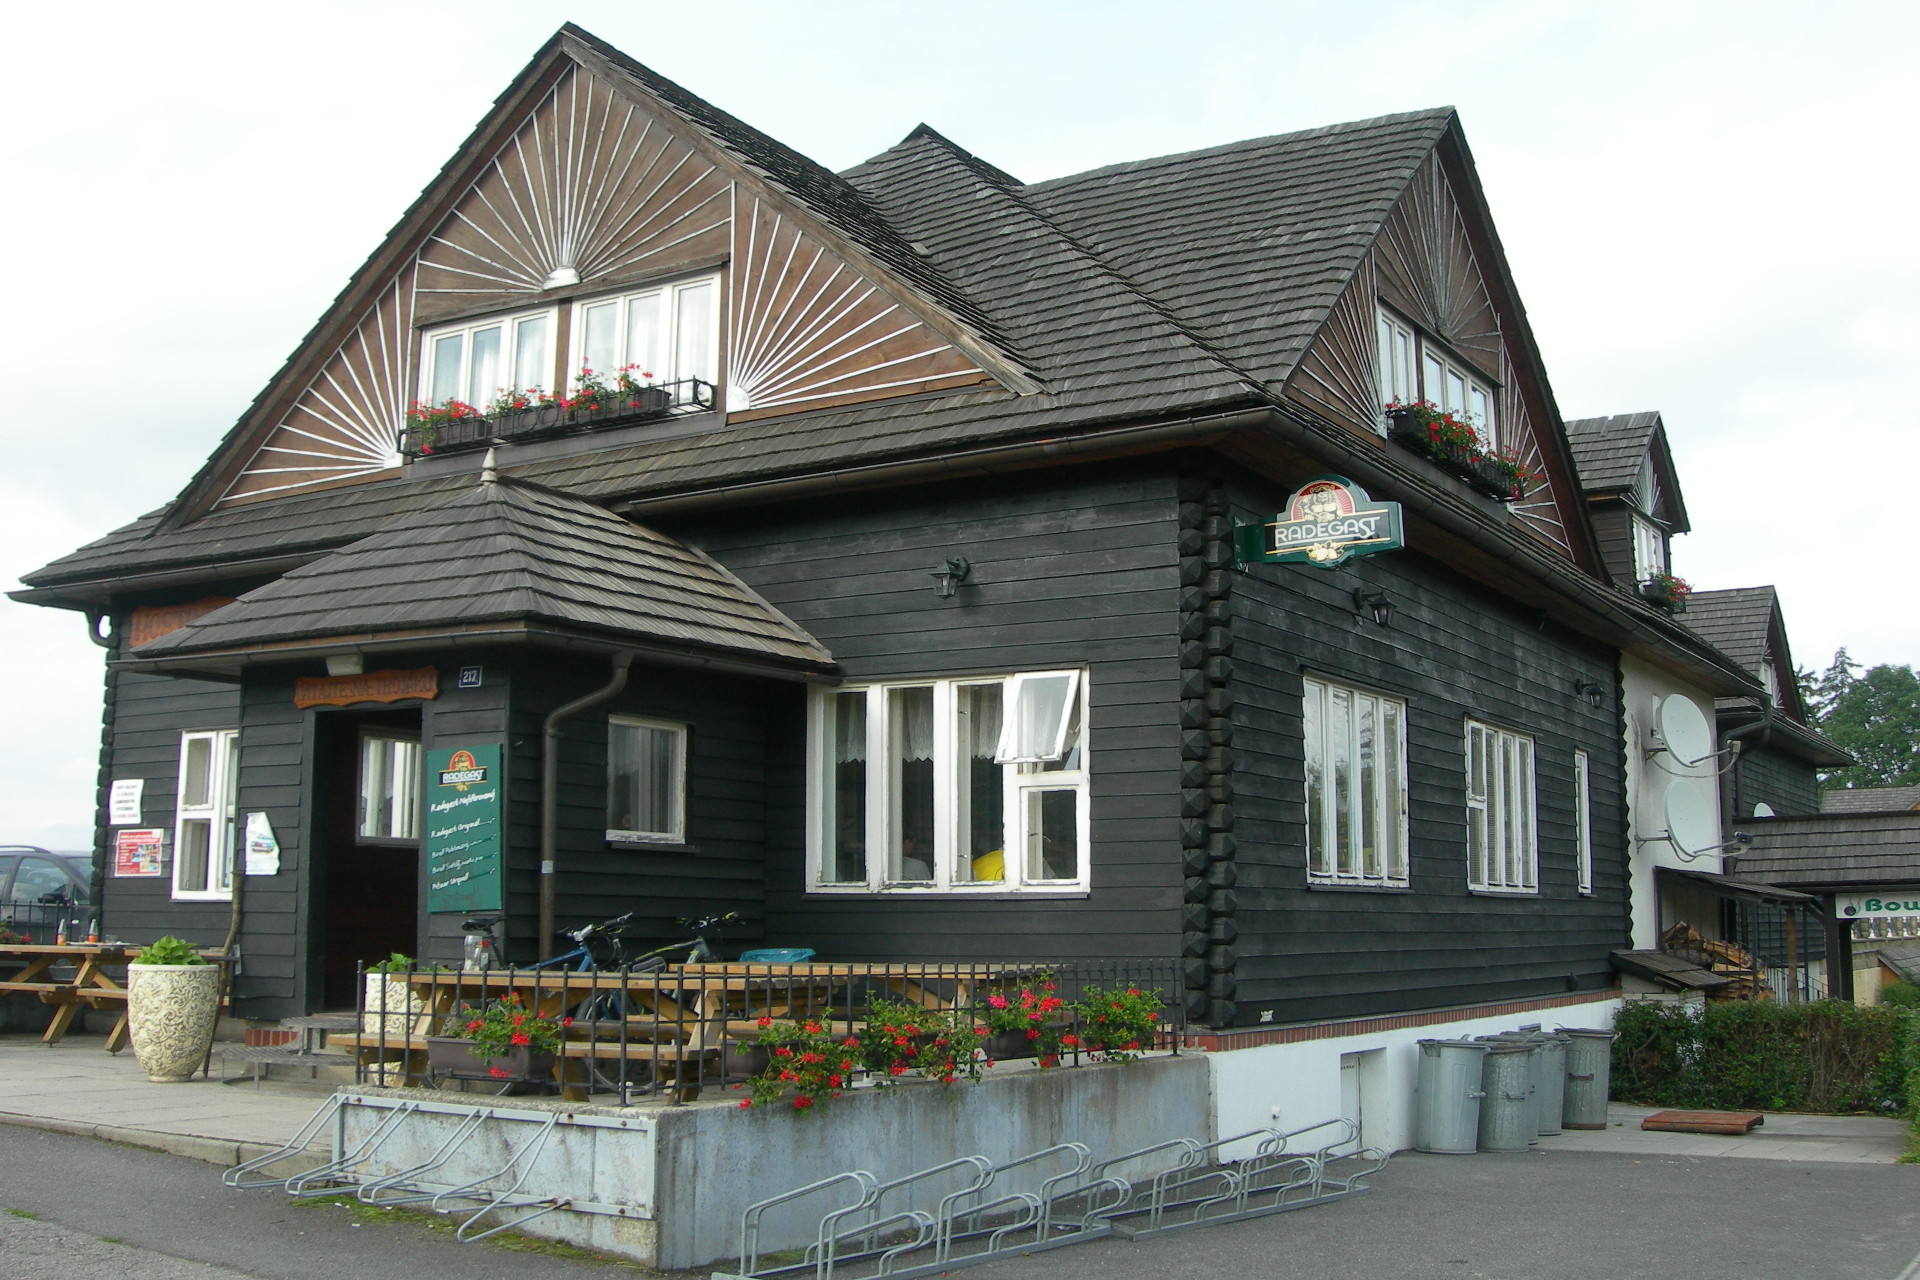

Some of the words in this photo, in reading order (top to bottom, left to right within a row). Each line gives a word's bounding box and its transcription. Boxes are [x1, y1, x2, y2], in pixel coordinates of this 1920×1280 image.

[1275, 516, 1380, 547] RADEGAST
[463, 670, 477, 682] 217
[443, 770, 484, 783] RADEGAST
[431, 798, 459, 813] Radegast
[431, 825, 457, 839] Radegast
